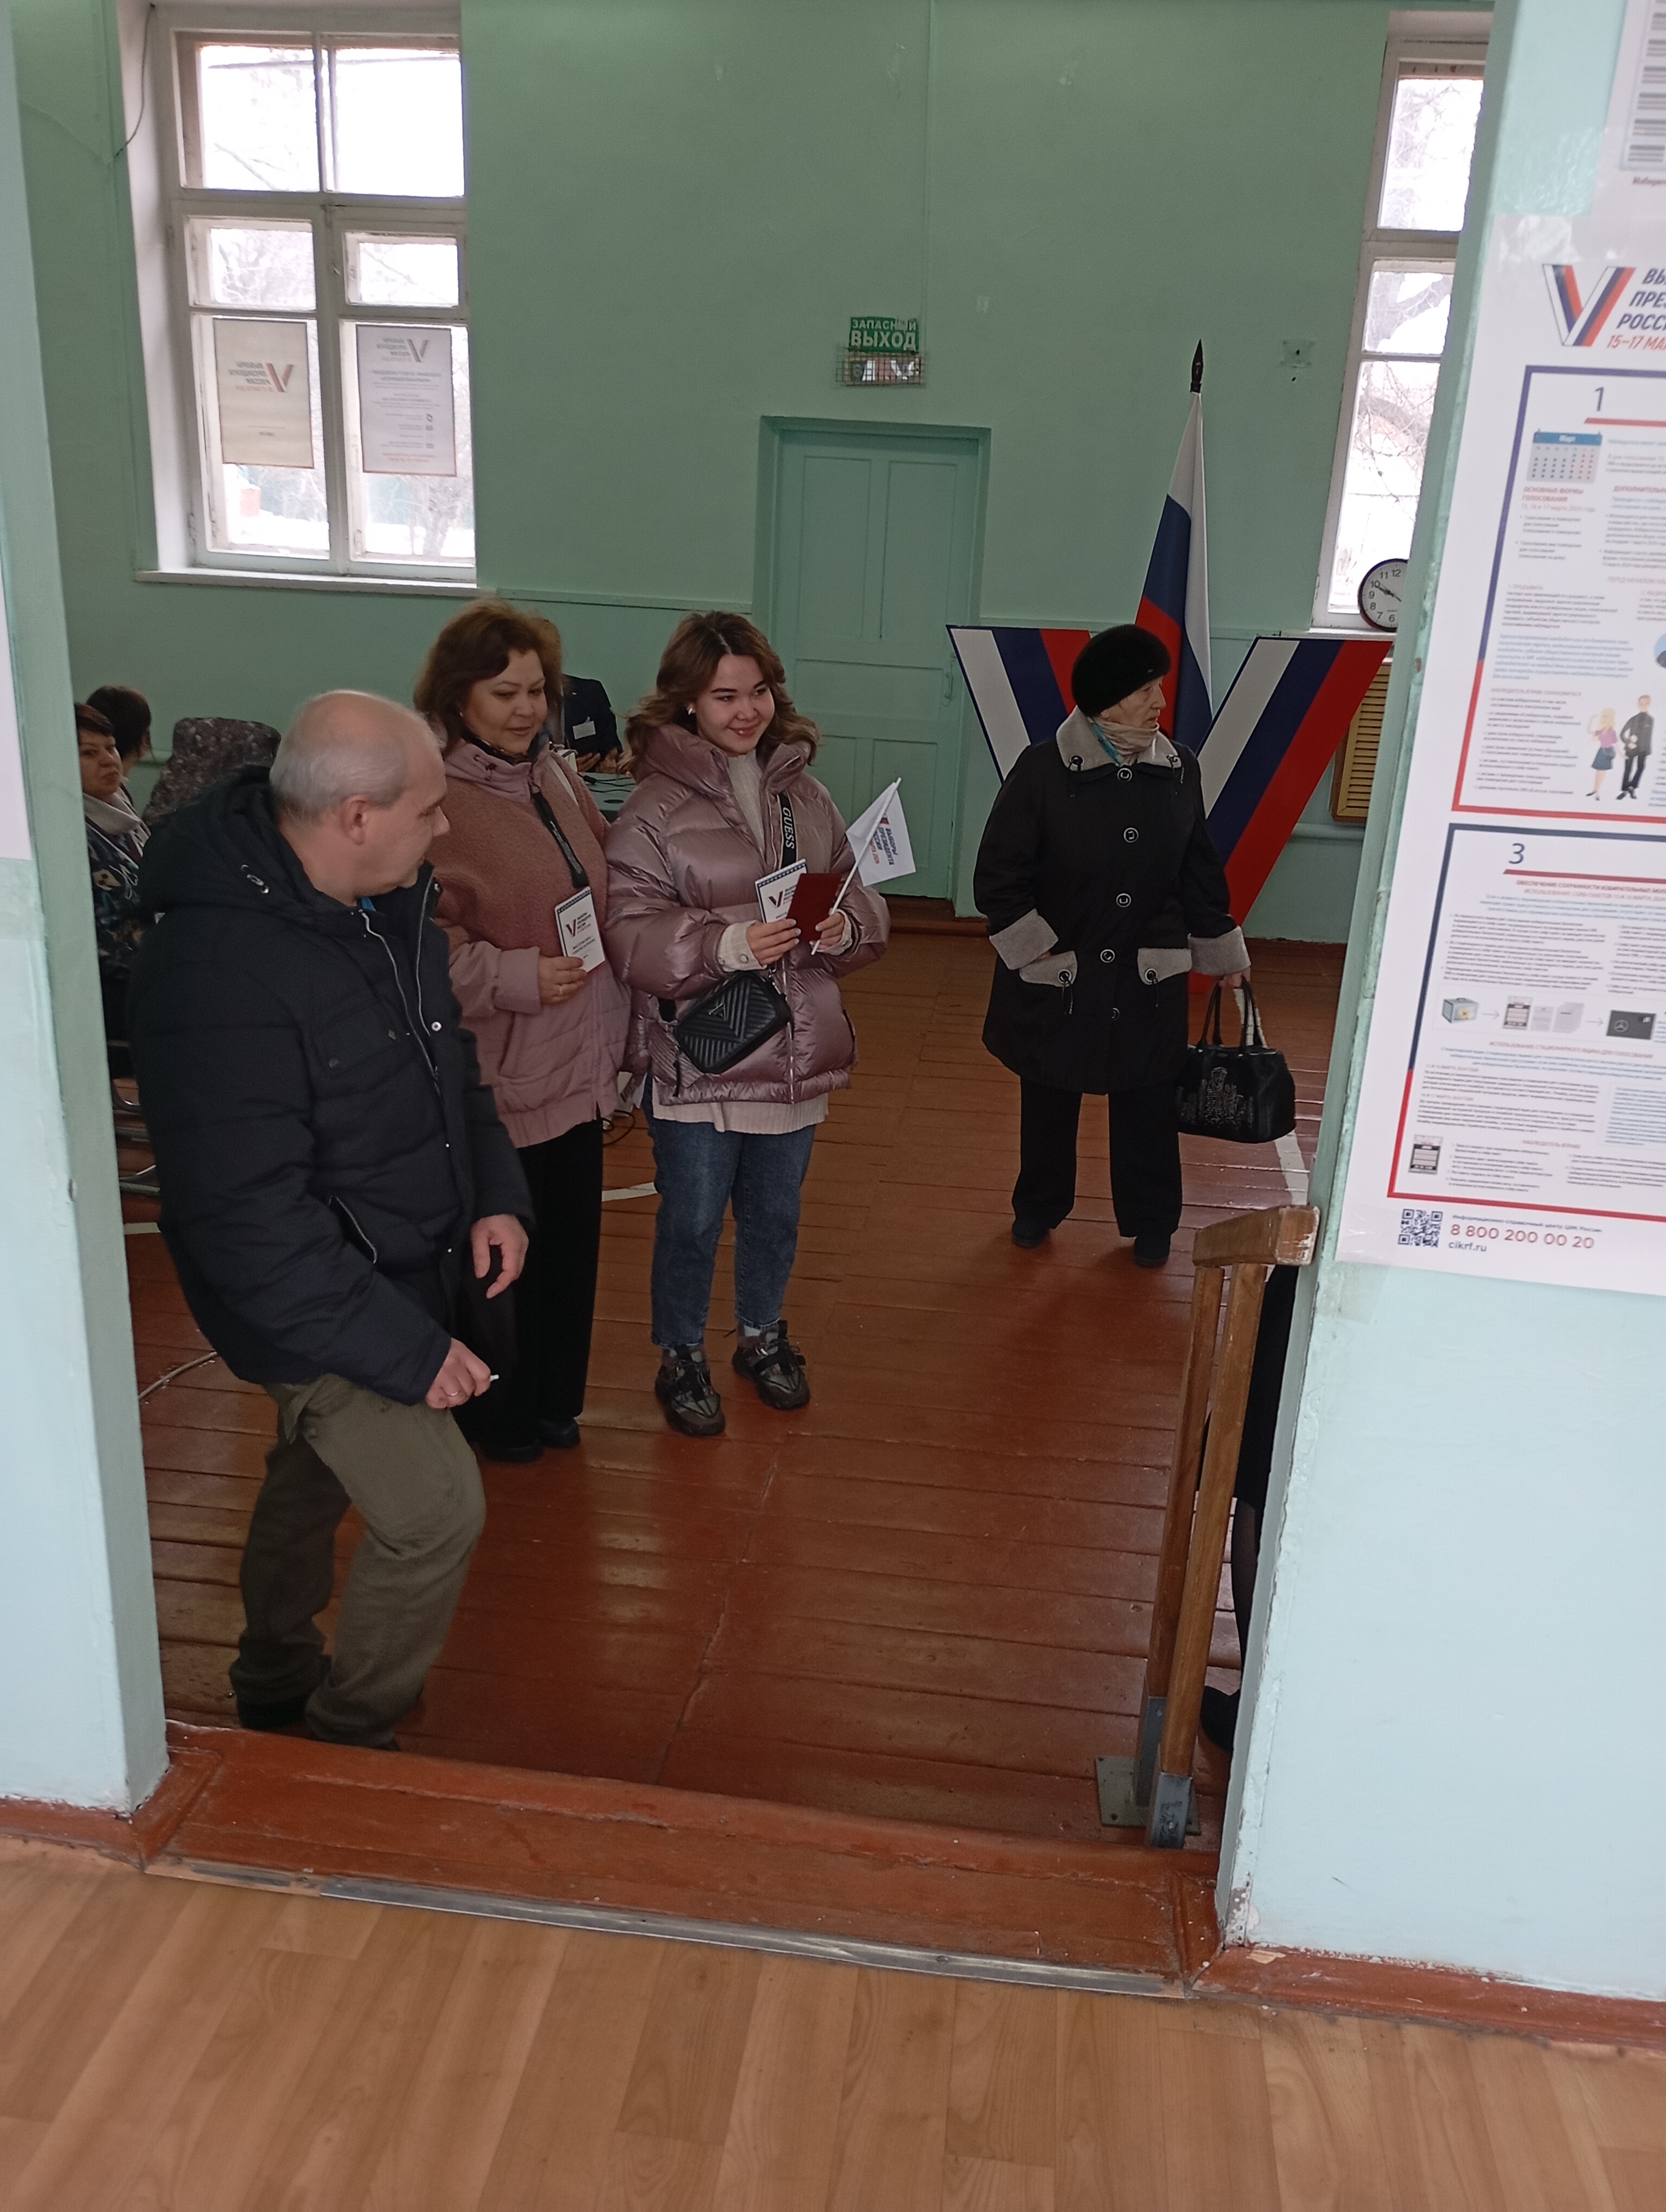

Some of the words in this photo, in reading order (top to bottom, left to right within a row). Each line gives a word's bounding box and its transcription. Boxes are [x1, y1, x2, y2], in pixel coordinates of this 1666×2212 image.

[1616, 313, 1666, 331] РОСС
[851, 330, 917, 351] ВЫХОД
[1643, 336, 1666, 351] МА
[1594, 387, 1604, 411] 1
[1370, 602, 1376, 610] 8
[783, 807, 794, 849] GUESS
[1508, 843, 1526, 864] 3
[1448, 1240, 1487, 1252] cikrf.ru
[1450, 1224, 1460, 1236] 8
[1466, 1225, 1500, 1239] 800
[1504, 1229, 1539, 1243] 200
[1544, 1233, 1567, 1246] 00
[1573, 1236, 1595, 1249] 20
